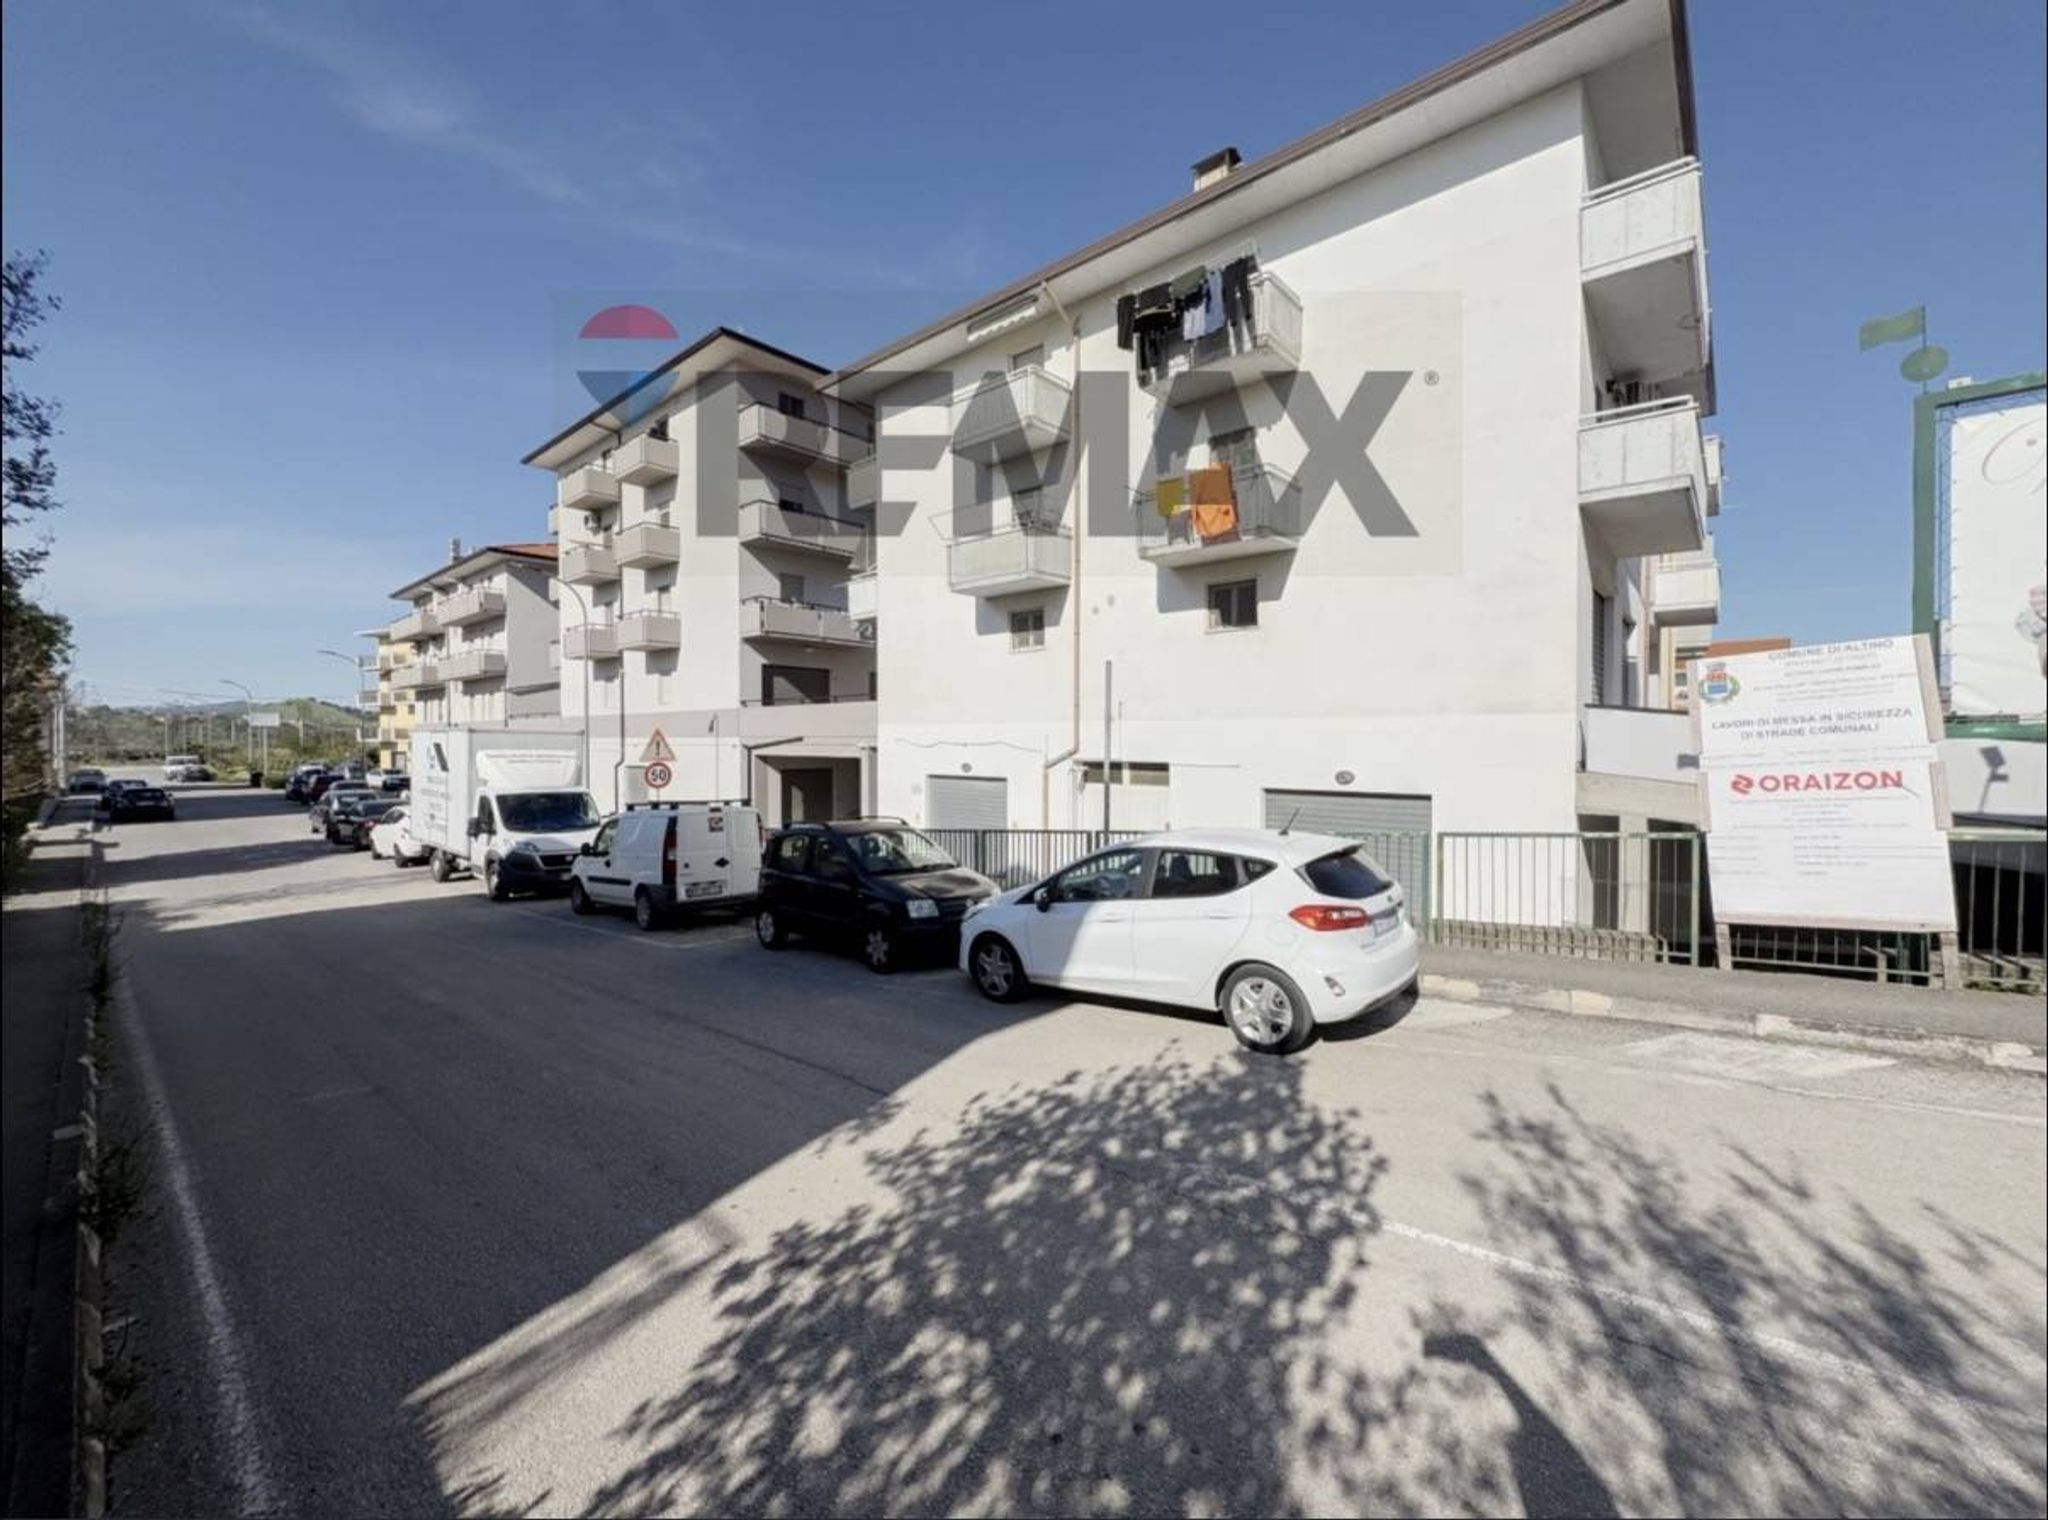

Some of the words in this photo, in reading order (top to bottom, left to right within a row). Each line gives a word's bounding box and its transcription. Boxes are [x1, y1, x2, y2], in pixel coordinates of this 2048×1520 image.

[1767, 646, 1822, 661] COMUNE
[1828, 643, 1841, 655] DI
[1842, 639, 1894, 653] ALTINO
[1711, 718, 1756, 730] LAVORI
[1757, 717, 1771, 728] DI
[1772, 714, 1816, 727] MESSA
[1818, 712, 1833, 722] IN
[1836, 708, 1913, 721] SICUREZZA
[1741, 730, 1754, 741] DI
[1757, 727, 1805, 739] STRADE
[1808, 723, 1879, 735] COMUNALI
[651, 768, 667, 782] 50
[1758, 770, 1904, 792] ORAIZON
